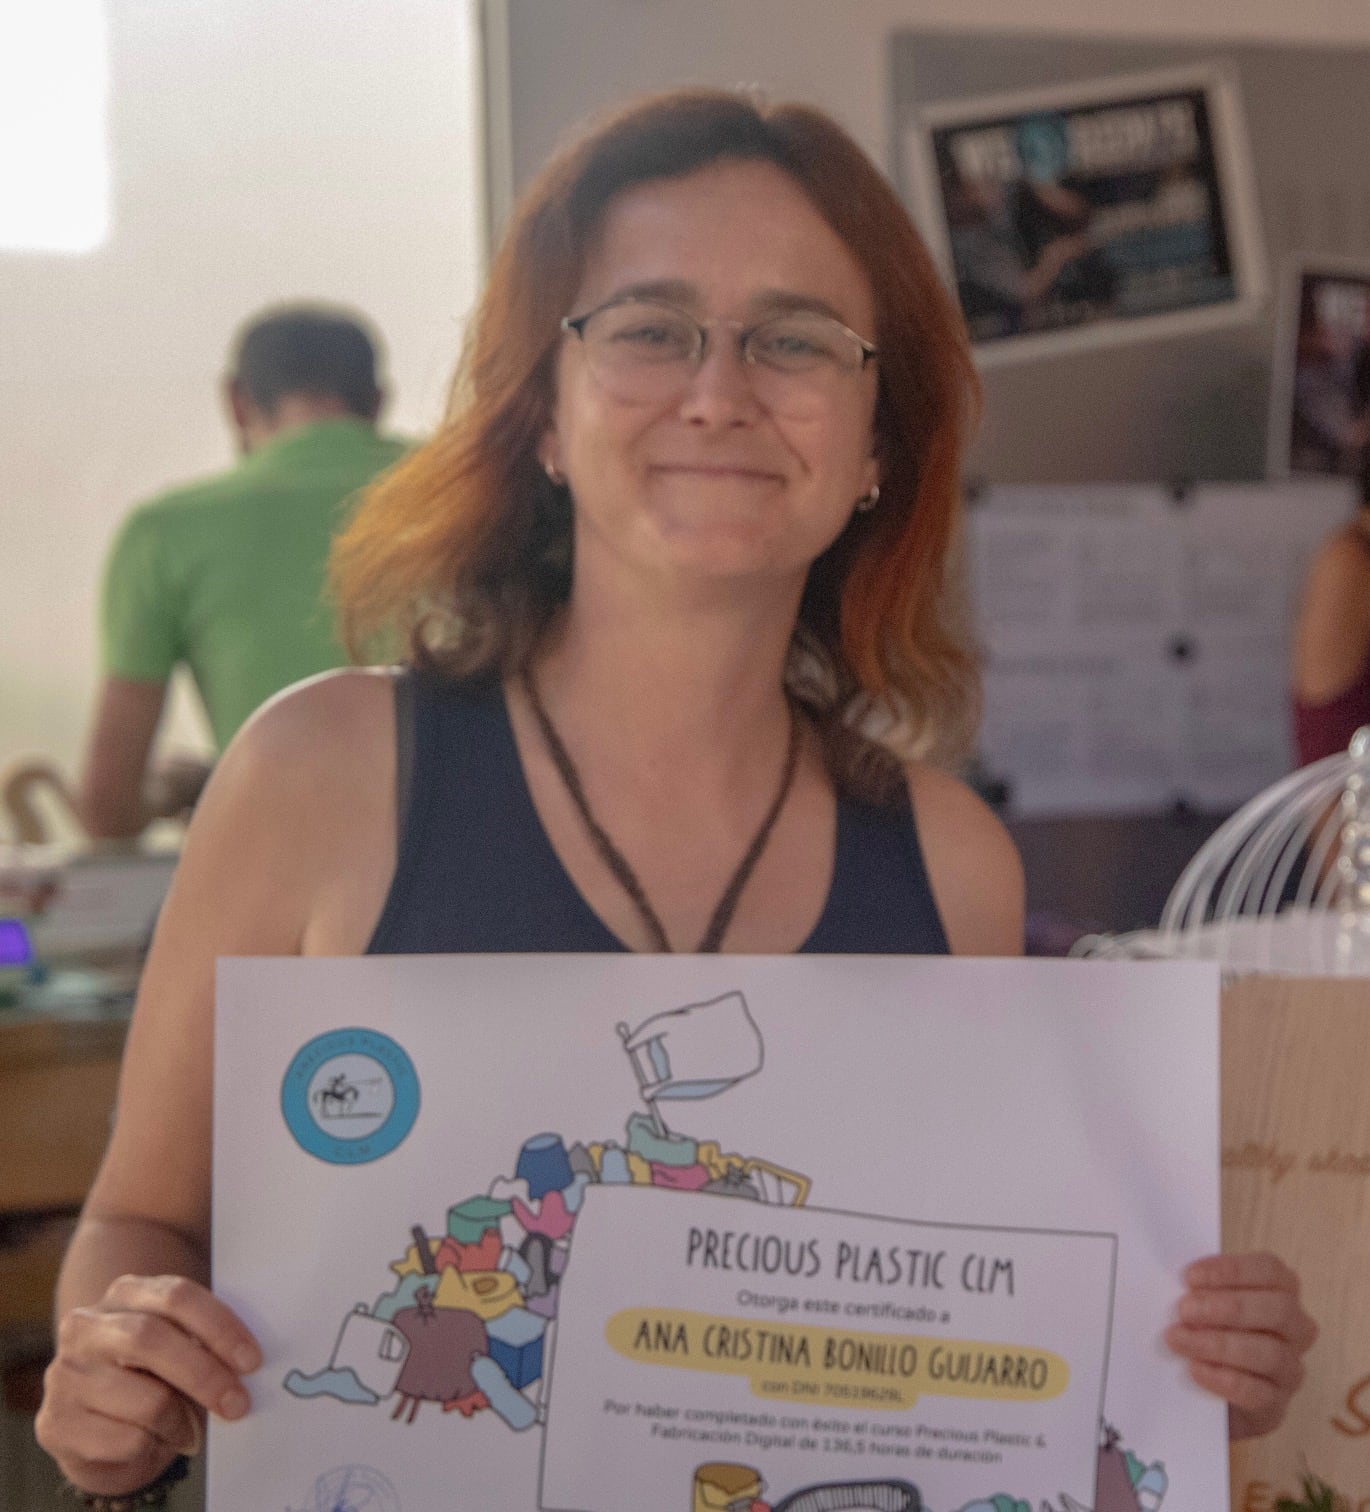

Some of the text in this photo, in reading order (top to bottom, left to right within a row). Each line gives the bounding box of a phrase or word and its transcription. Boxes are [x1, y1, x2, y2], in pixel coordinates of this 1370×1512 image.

[686, 1227, 1016, 1296] PRECIOUS PLASTIC CLM
[736, 1288, 952, 1324] Otorga este certificado a
[633, 1319, 1049, 1391] ANA CRISTINA BONILLO GUIJARRO
[603, 1399, 631, 1415] Por
[634, 1402, 679, 1419] haber
[684, 1408, 777, 1428] completado
[780, 1416, 809, 1430] con
[852, 1418, 868, 1433] el
[870, 1422, 912, 1437] curso
[915, 1423, 979, 1443] Precious
[983, 1428, 1032, 1447] Plastic
[745, 1428, 797, 1450] Digital
[799, 1435, 819, 1449] de
[869, 1440, 911, 1457] horas
[914, 1443, 935, 1459] de
